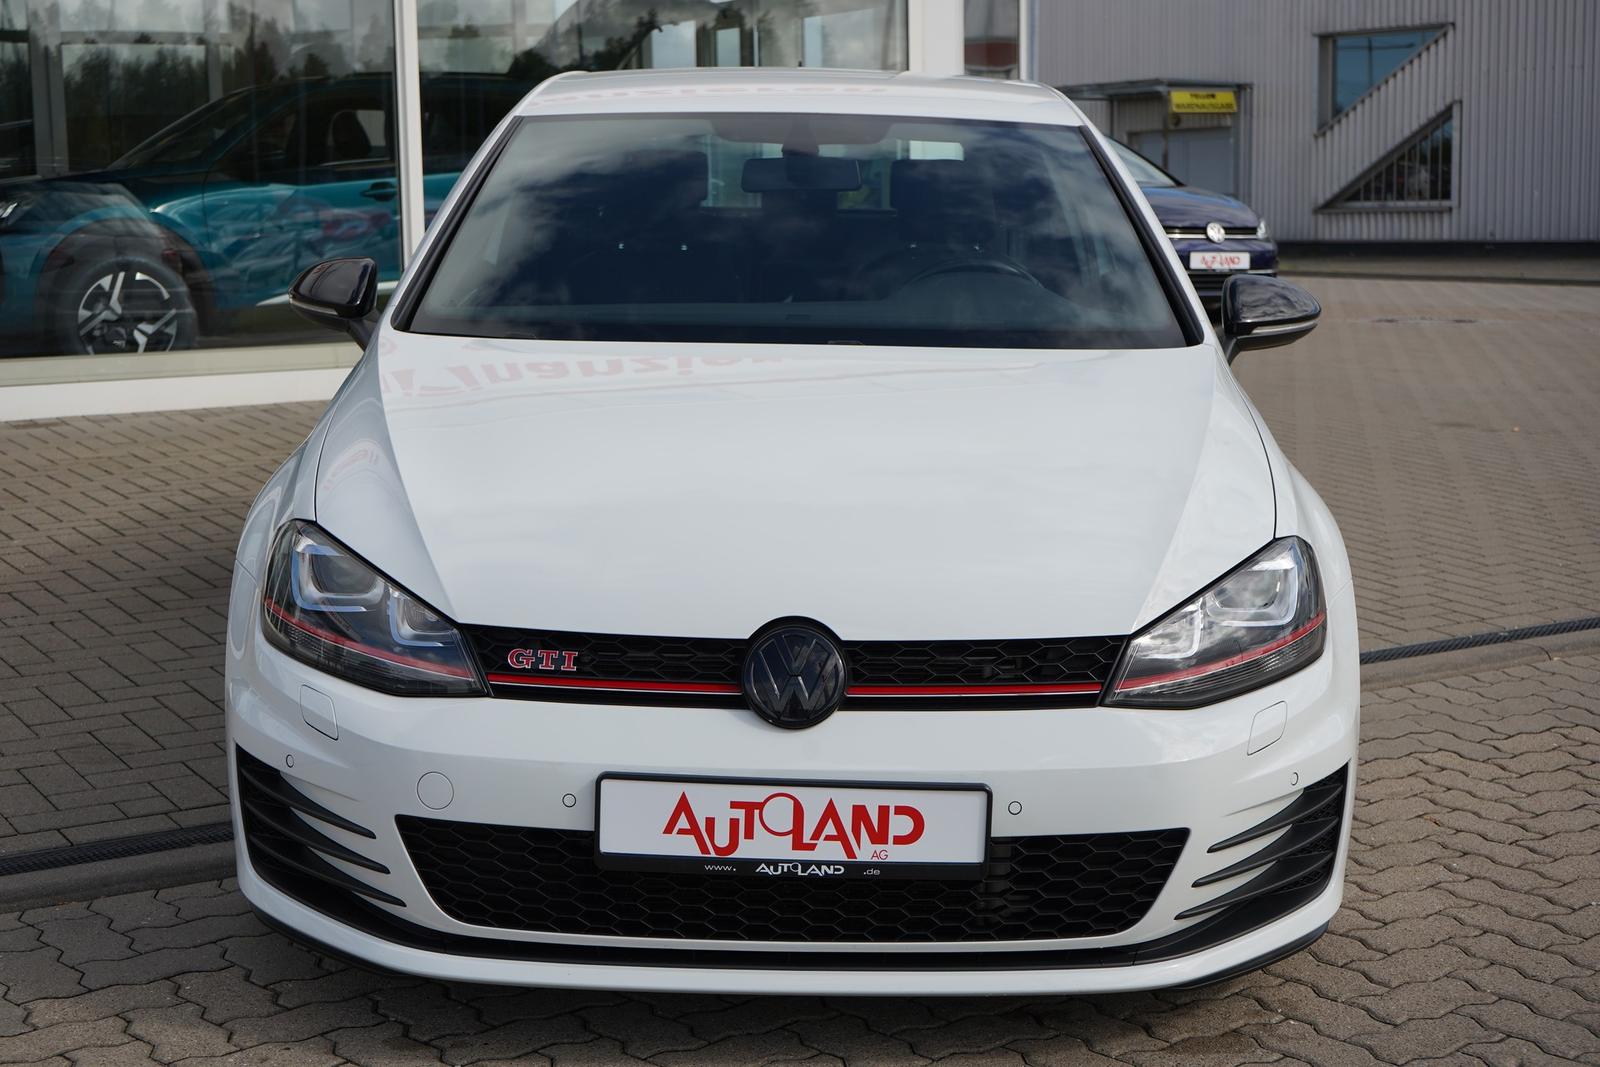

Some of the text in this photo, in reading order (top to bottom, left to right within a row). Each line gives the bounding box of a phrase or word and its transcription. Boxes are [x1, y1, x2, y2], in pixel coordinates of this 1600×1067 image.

[508, 648, 578, 671] GTI
[747, 626, 844, 722] VW
[662, 791, 925, 859] AUTOLAND
[870, 849, 889, 861] AG
[704, 862, 881, 877] www. AUTOLAND .de
